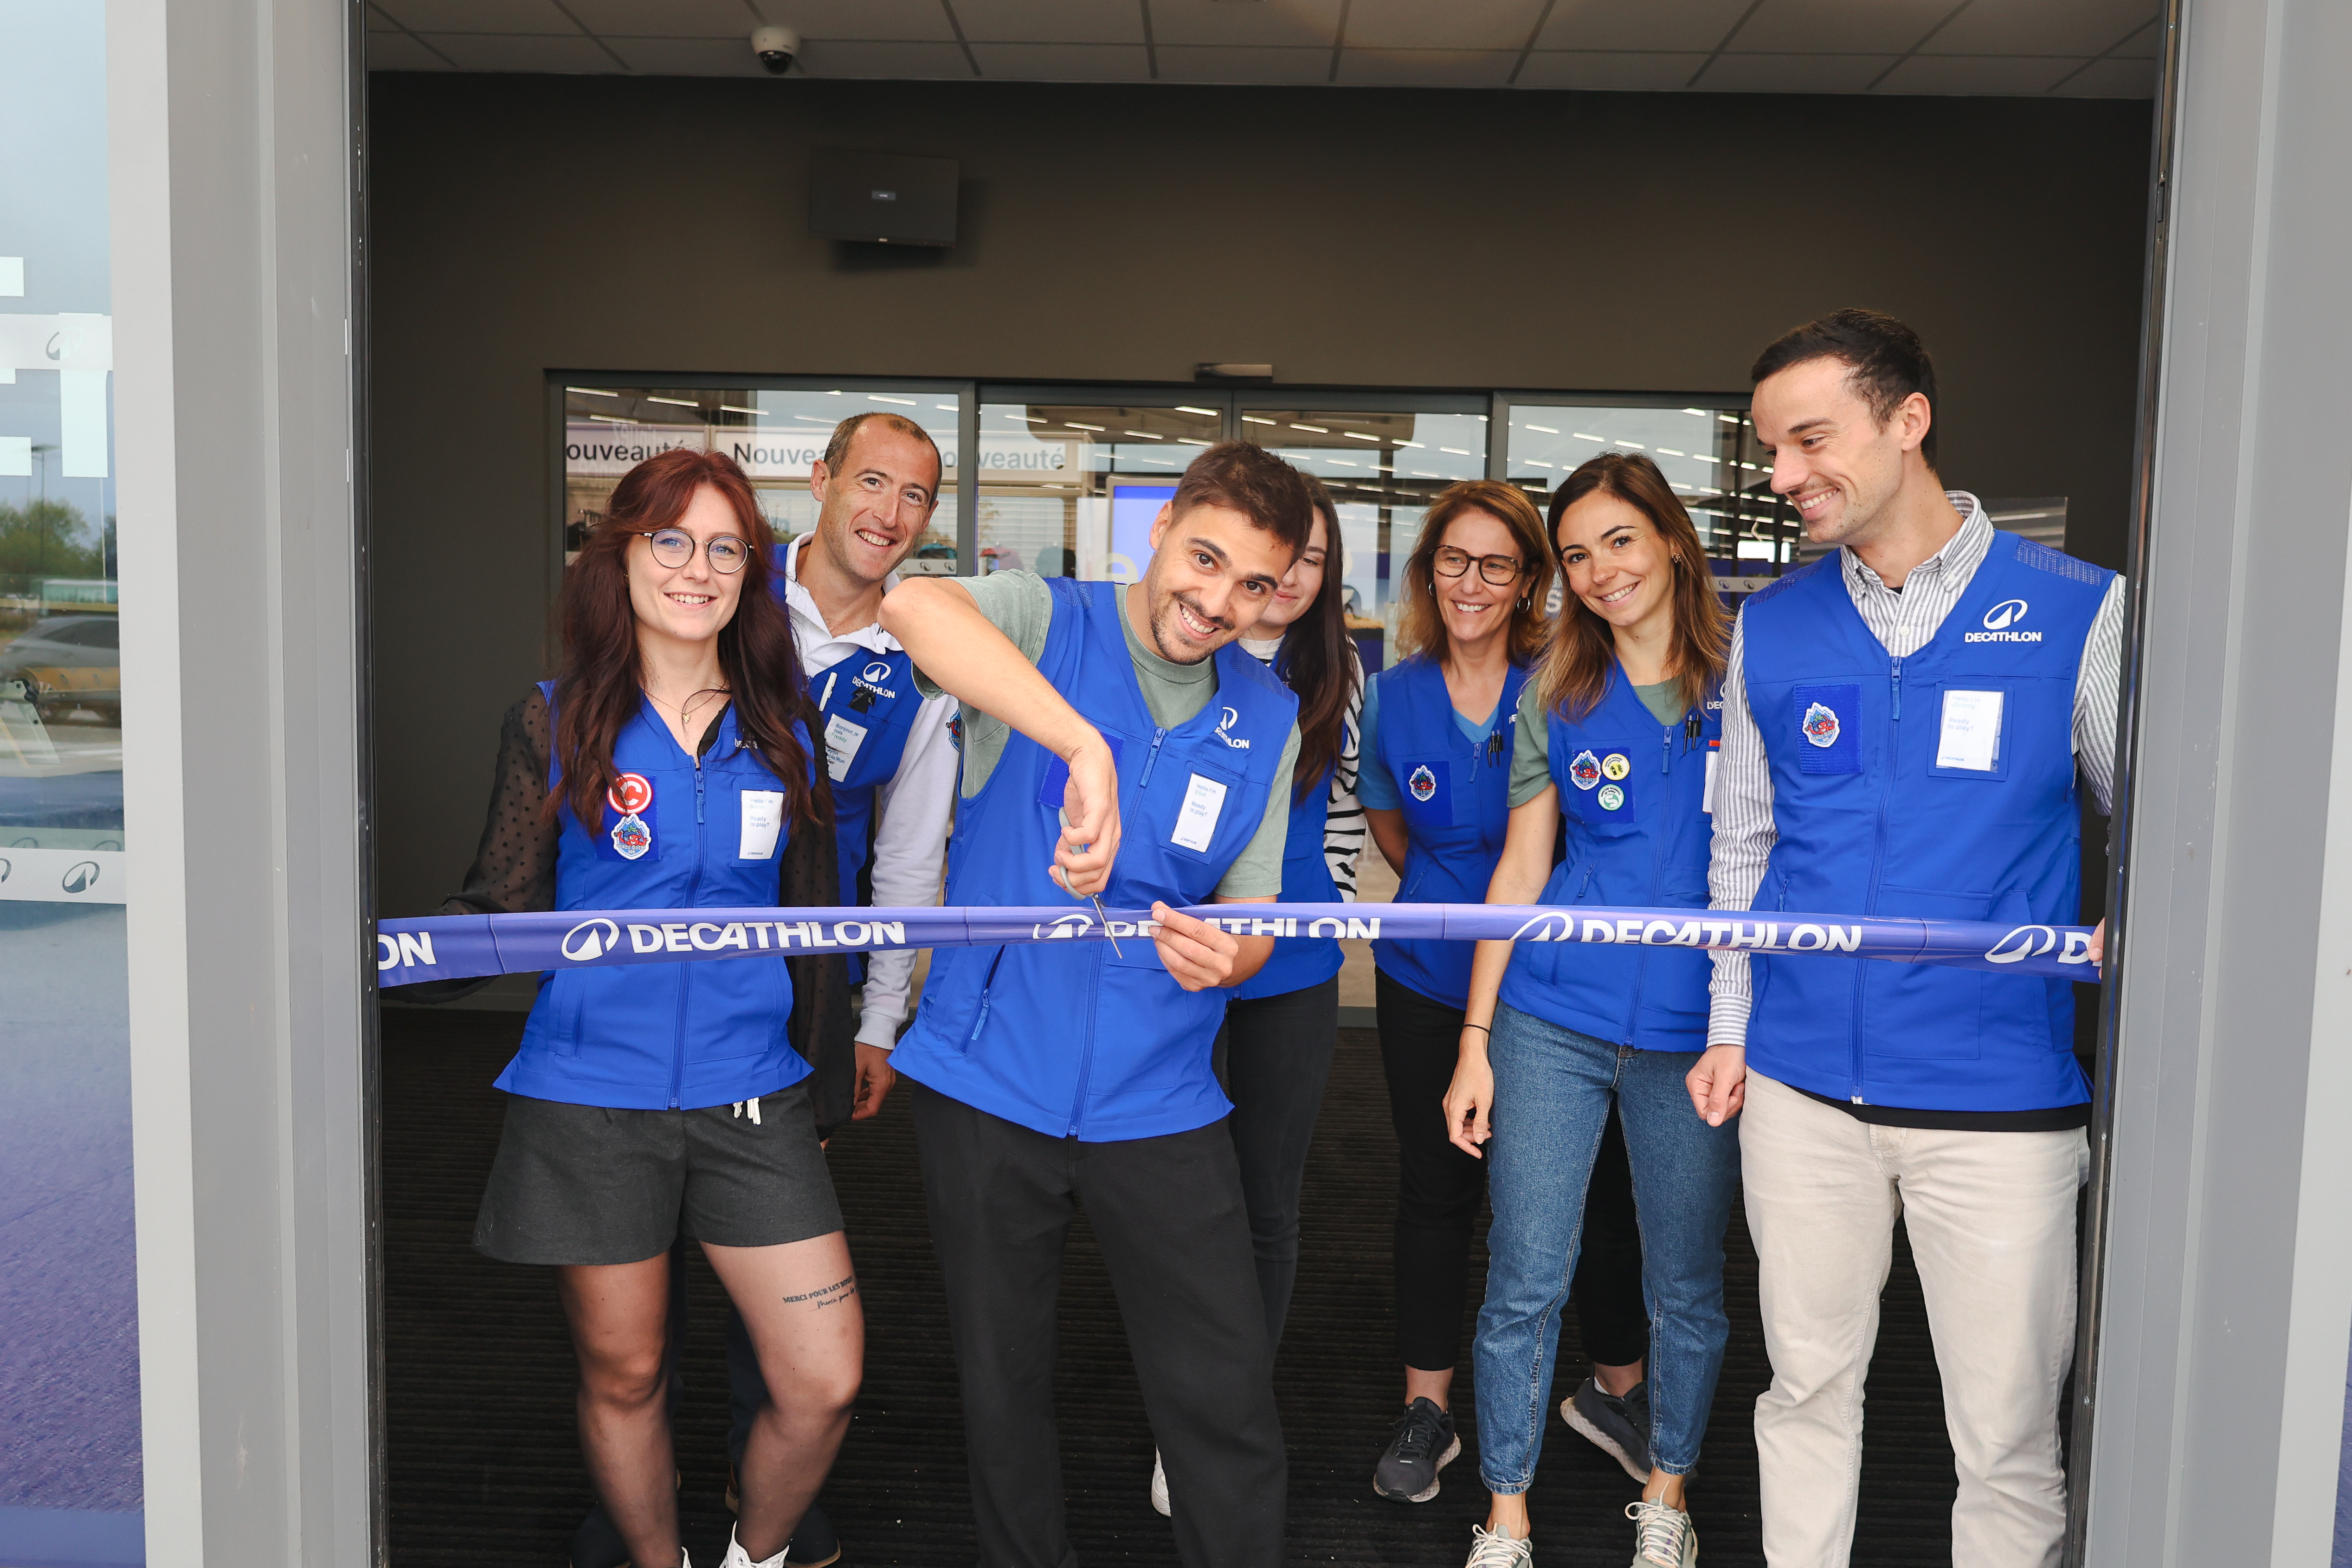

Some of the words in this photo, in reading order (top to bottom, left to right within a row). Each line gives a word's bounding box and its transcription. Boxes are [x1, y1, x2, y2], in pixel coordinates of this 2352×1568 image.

[567, 440, 684, 461] ouveau
[1965, 631, 2042, 643] DECATHLON
[852, 676, 896, 699] DECATHLON
[835, 723, 854, 736] Bonjour,
[831, 732, 848, 743] Freddy
[1194, 789, 1207, 798] Elliot
[1196, 783, 1208, 792] Hello
[1191, 800, 1206, 810] Ready
[1194, 808, 1208, 817] play?
[627, 921, 906, 954] DECATHLON
[1580, 919, 1862, 952] DECATHLON
[782, 1294, 807, 1303] MERCI
[809, 1288, 828, 1299] POUR
[828, 1283, 840, 1292] LES
